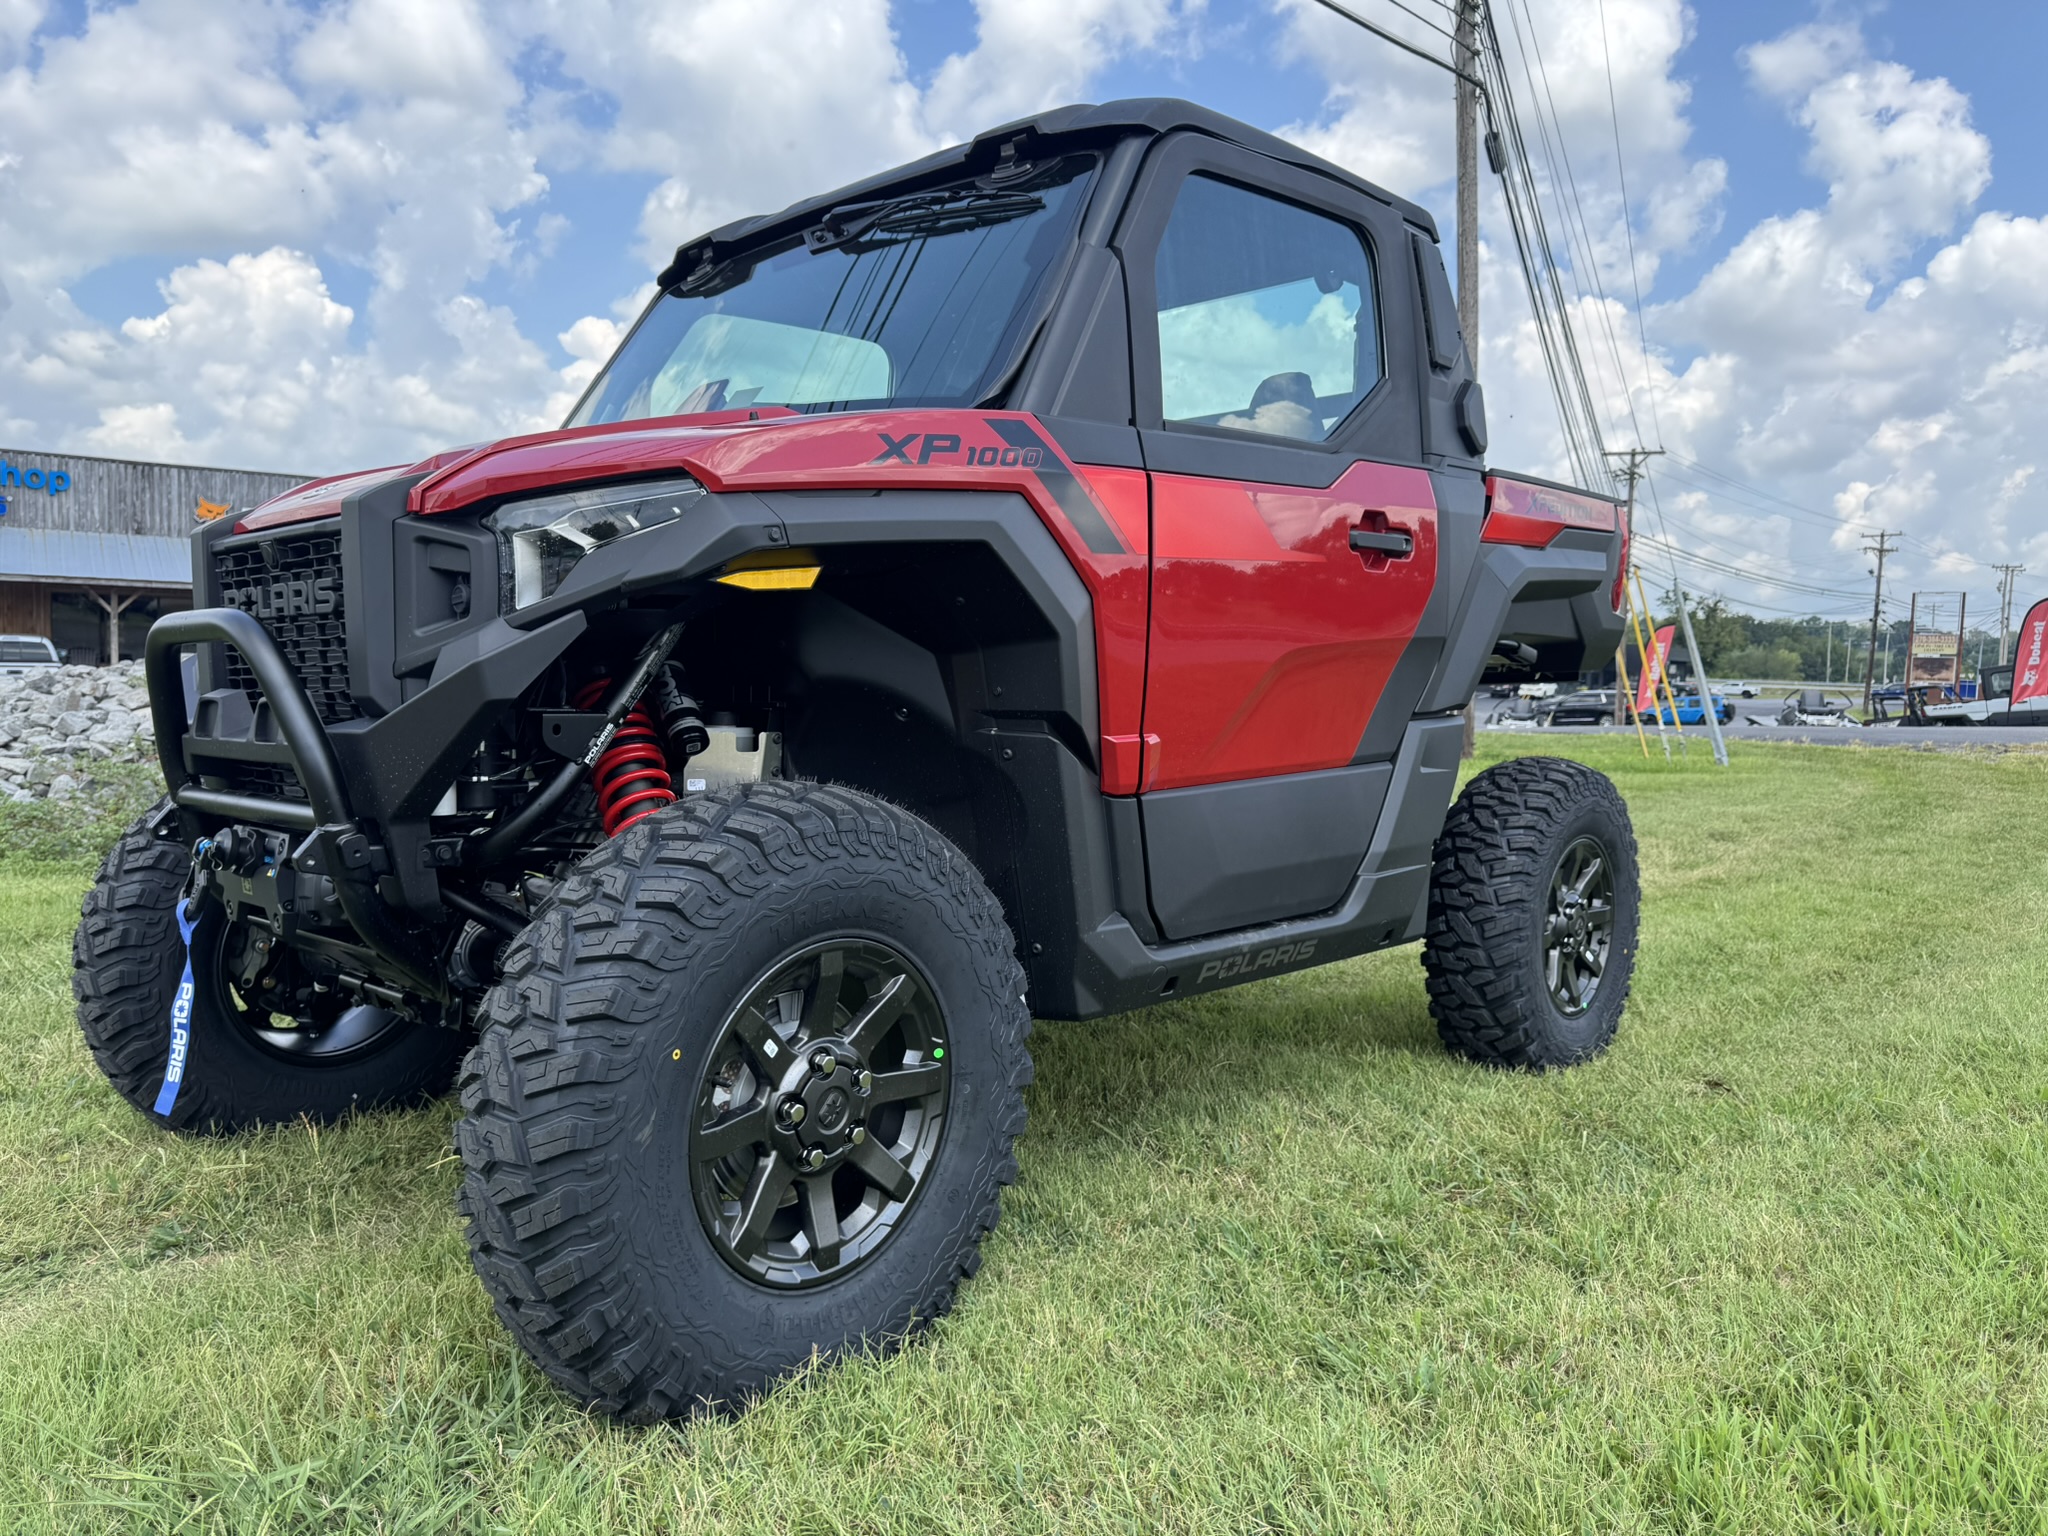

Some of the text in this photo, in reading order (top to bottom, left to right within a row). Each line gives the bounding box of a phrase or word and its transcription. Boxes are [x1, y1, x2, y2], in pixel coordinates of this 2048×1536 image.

[868, 434, 1043, 468] XP 1000
[224, 578, 335, 618] POLARIS
[2028, 621, 2047, 666] Bobcat
[584, 722, 615, 765] POLARIS
[1197, 939, 1318, 984] POLARIS
[167, 982, 193, 1083] POLARIS
